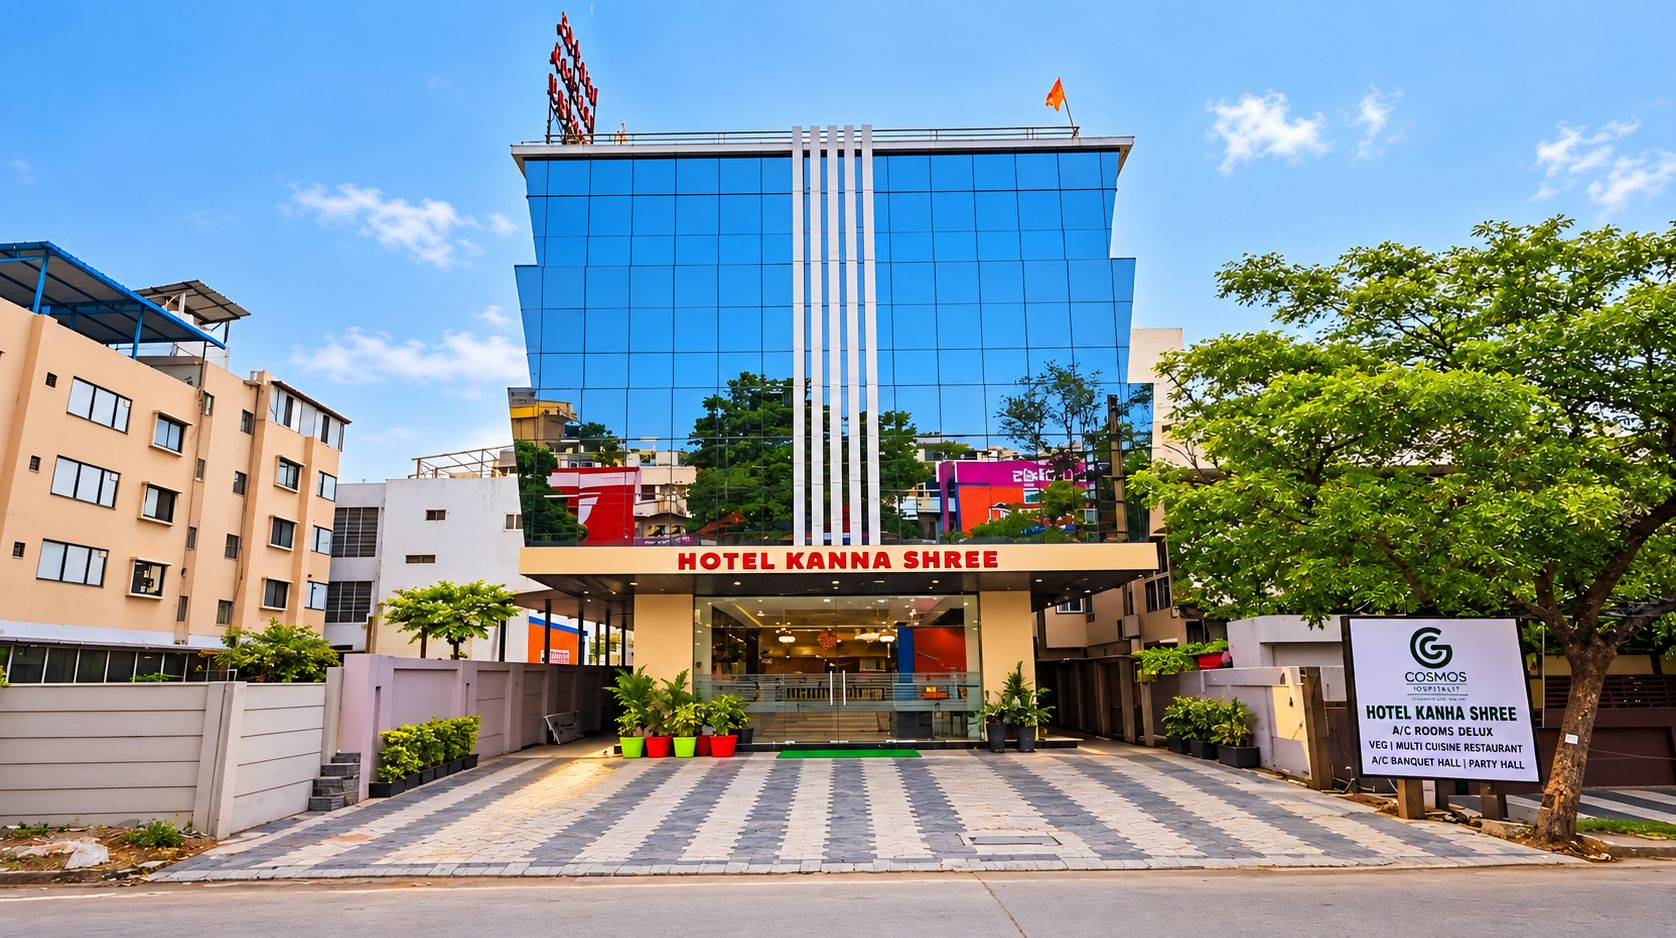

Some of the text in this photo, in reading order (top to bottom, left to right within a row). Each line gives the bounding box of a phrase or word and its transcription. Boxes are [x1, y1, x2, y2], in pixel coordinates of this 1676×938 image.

[678, 550, 998, 570] HOTEL KANNA SHREE
[1404, 671, 1467, 683] COSMOS
[1366, 704, 1518, 722] HOTEL KANHA SHREE
[1392, 725, 1494, 738] A/C ROOMS DELUX
[1368, 740, 1523, 754] VEG MULTI CUISINE RESTAURANT
[1371, 755, 1525, 770] A/C BANQUET HALL PARTY HALL
